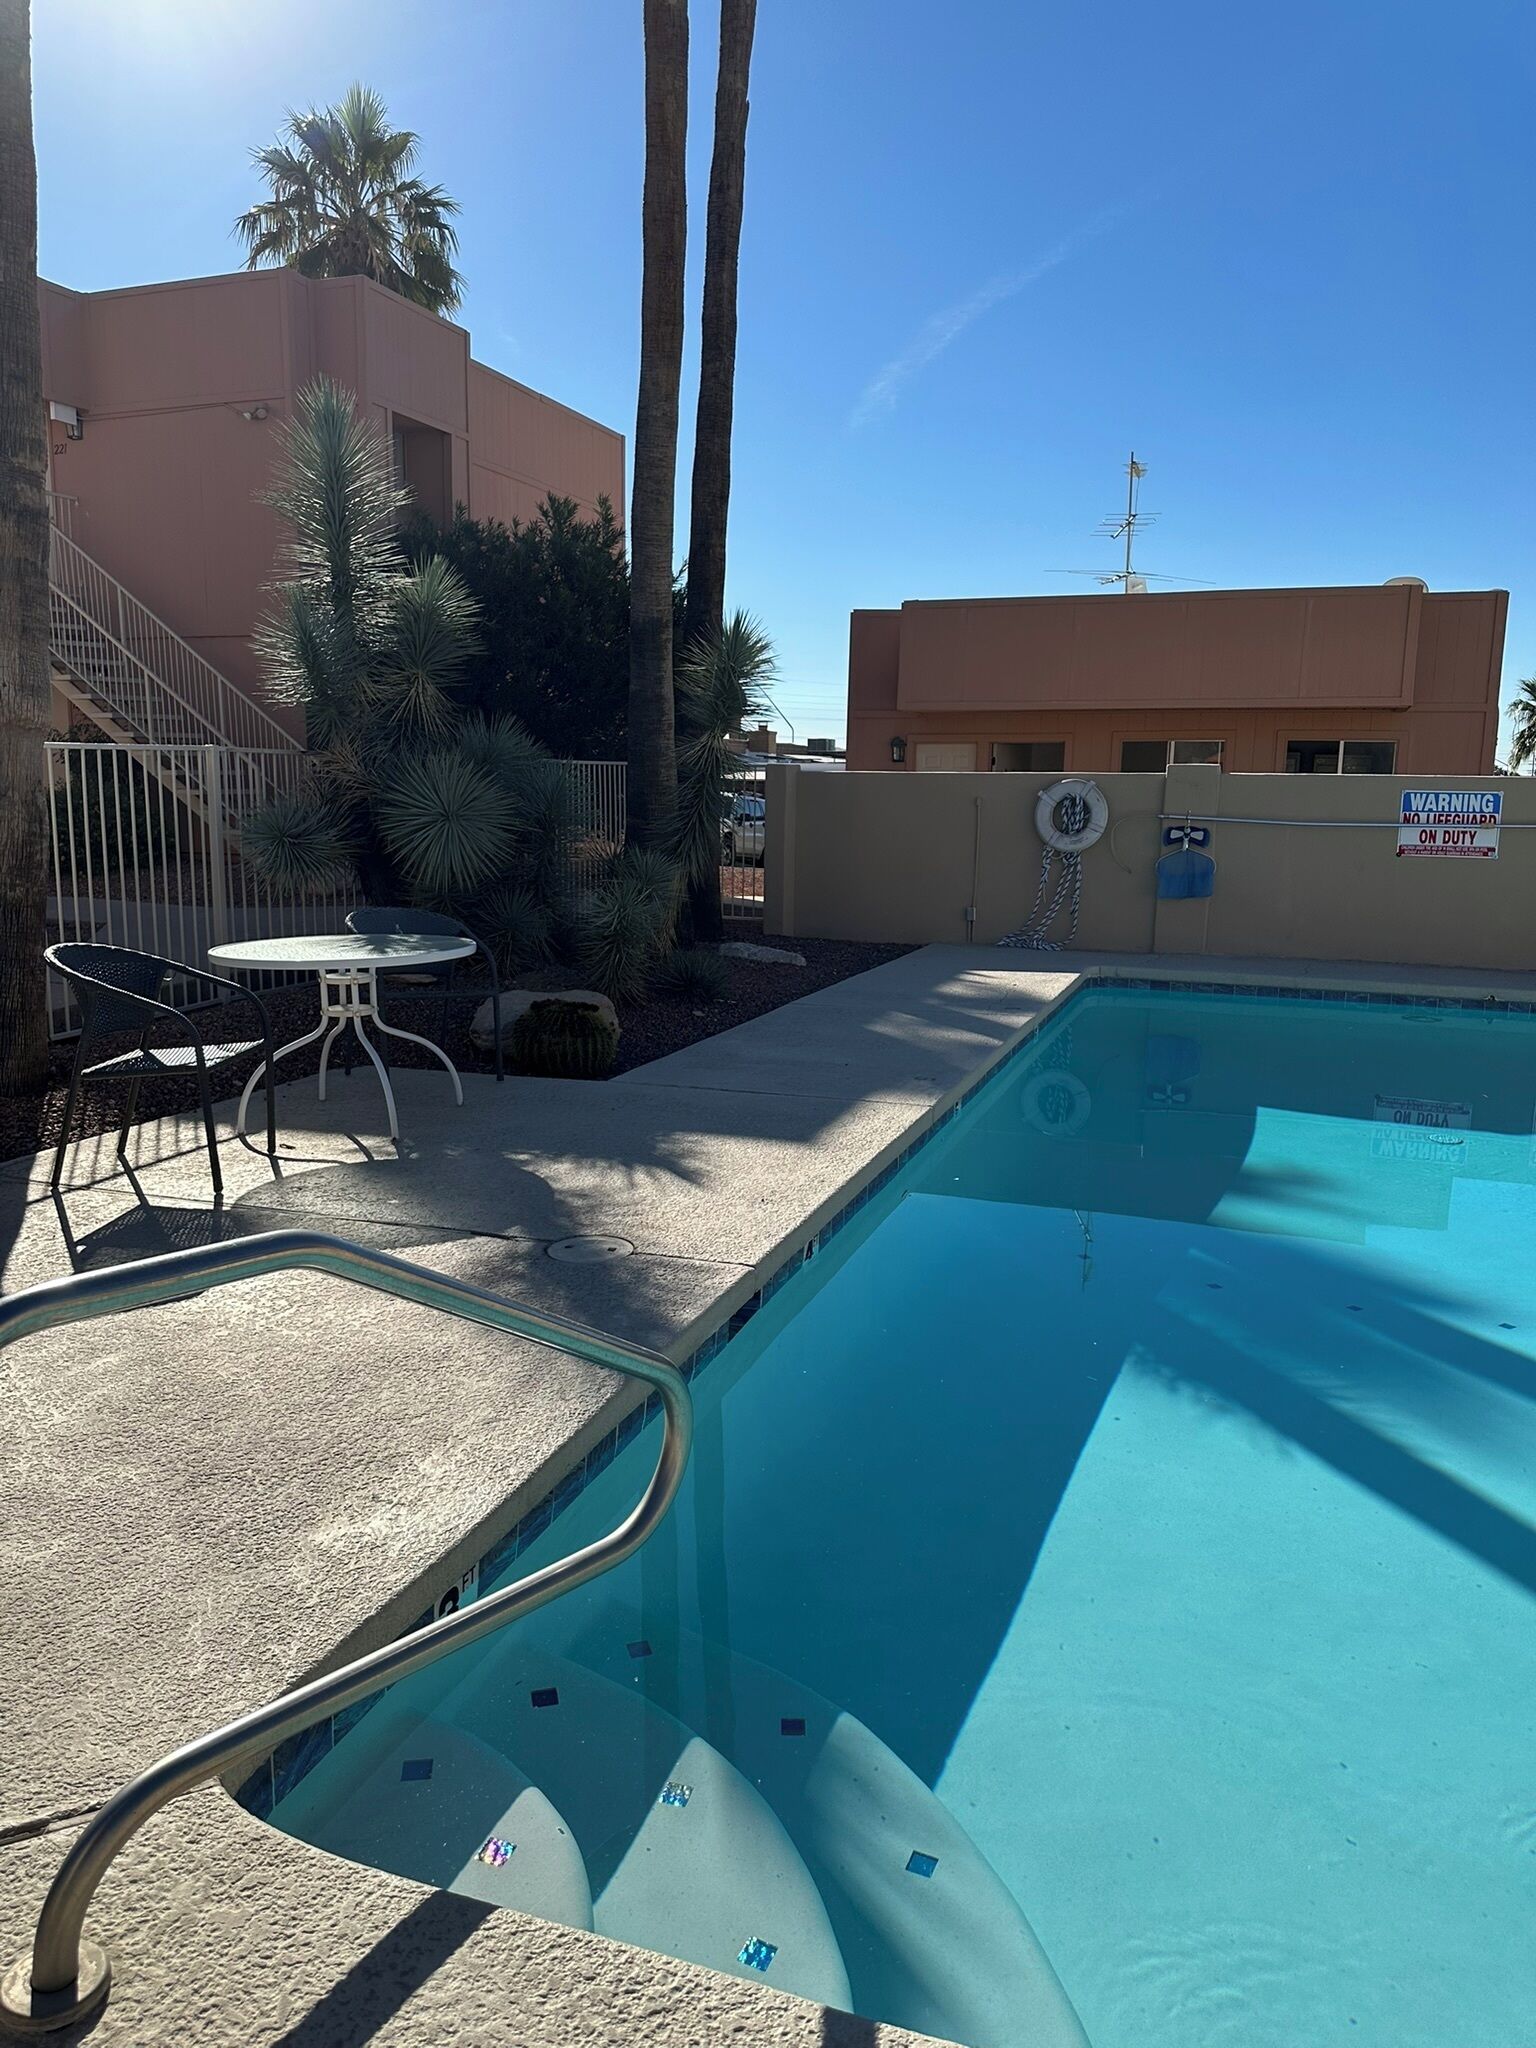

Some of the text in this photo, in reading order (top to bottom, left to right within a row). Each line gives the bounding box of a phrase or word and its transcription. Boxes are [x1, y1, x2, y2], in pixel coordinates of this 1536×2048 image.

[54, 443, 67, 455] 221
[1410, 793, 1494, 813] WARNING
[1419, 829, 1477, 845] ON DUTY
[461, 1565, 476, 1593] FT
